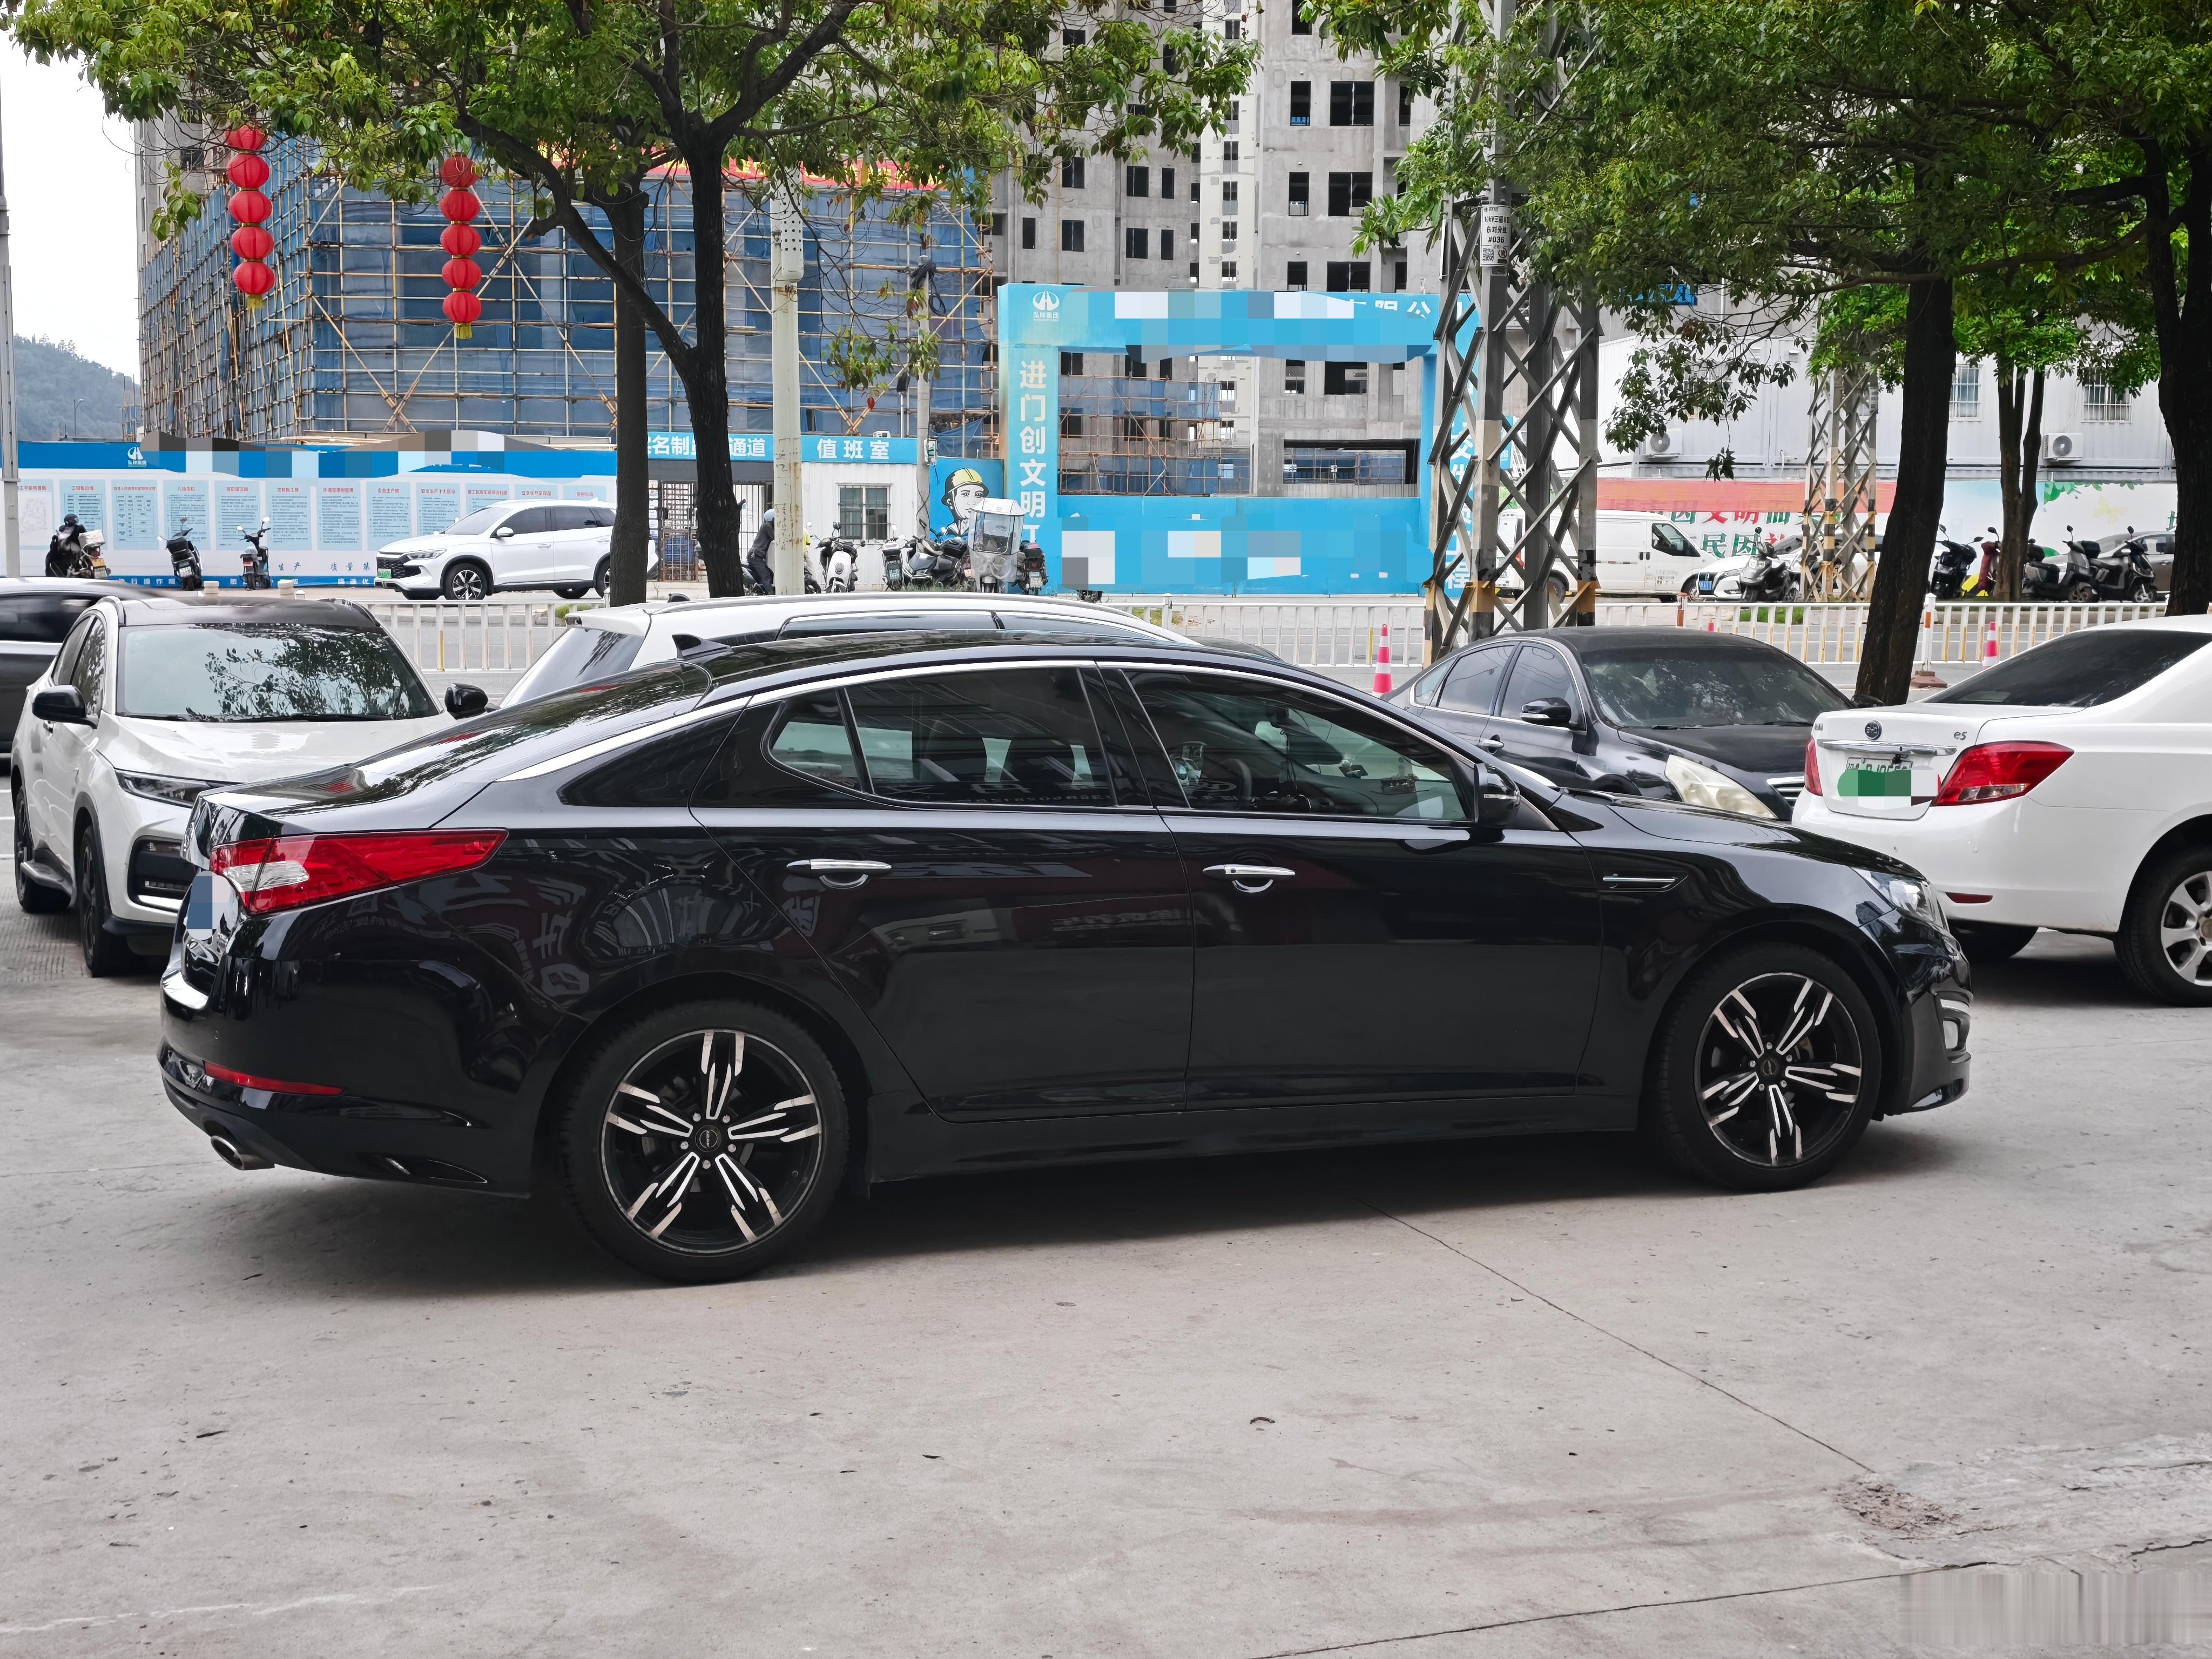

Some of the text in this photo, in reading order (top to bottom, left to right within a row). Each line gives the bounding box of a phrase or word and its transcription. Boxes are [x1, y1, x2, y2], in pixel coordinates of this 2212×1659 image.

[817, 438, 889, 460] 值班室
[1953, 731, 1967, 740] e5
